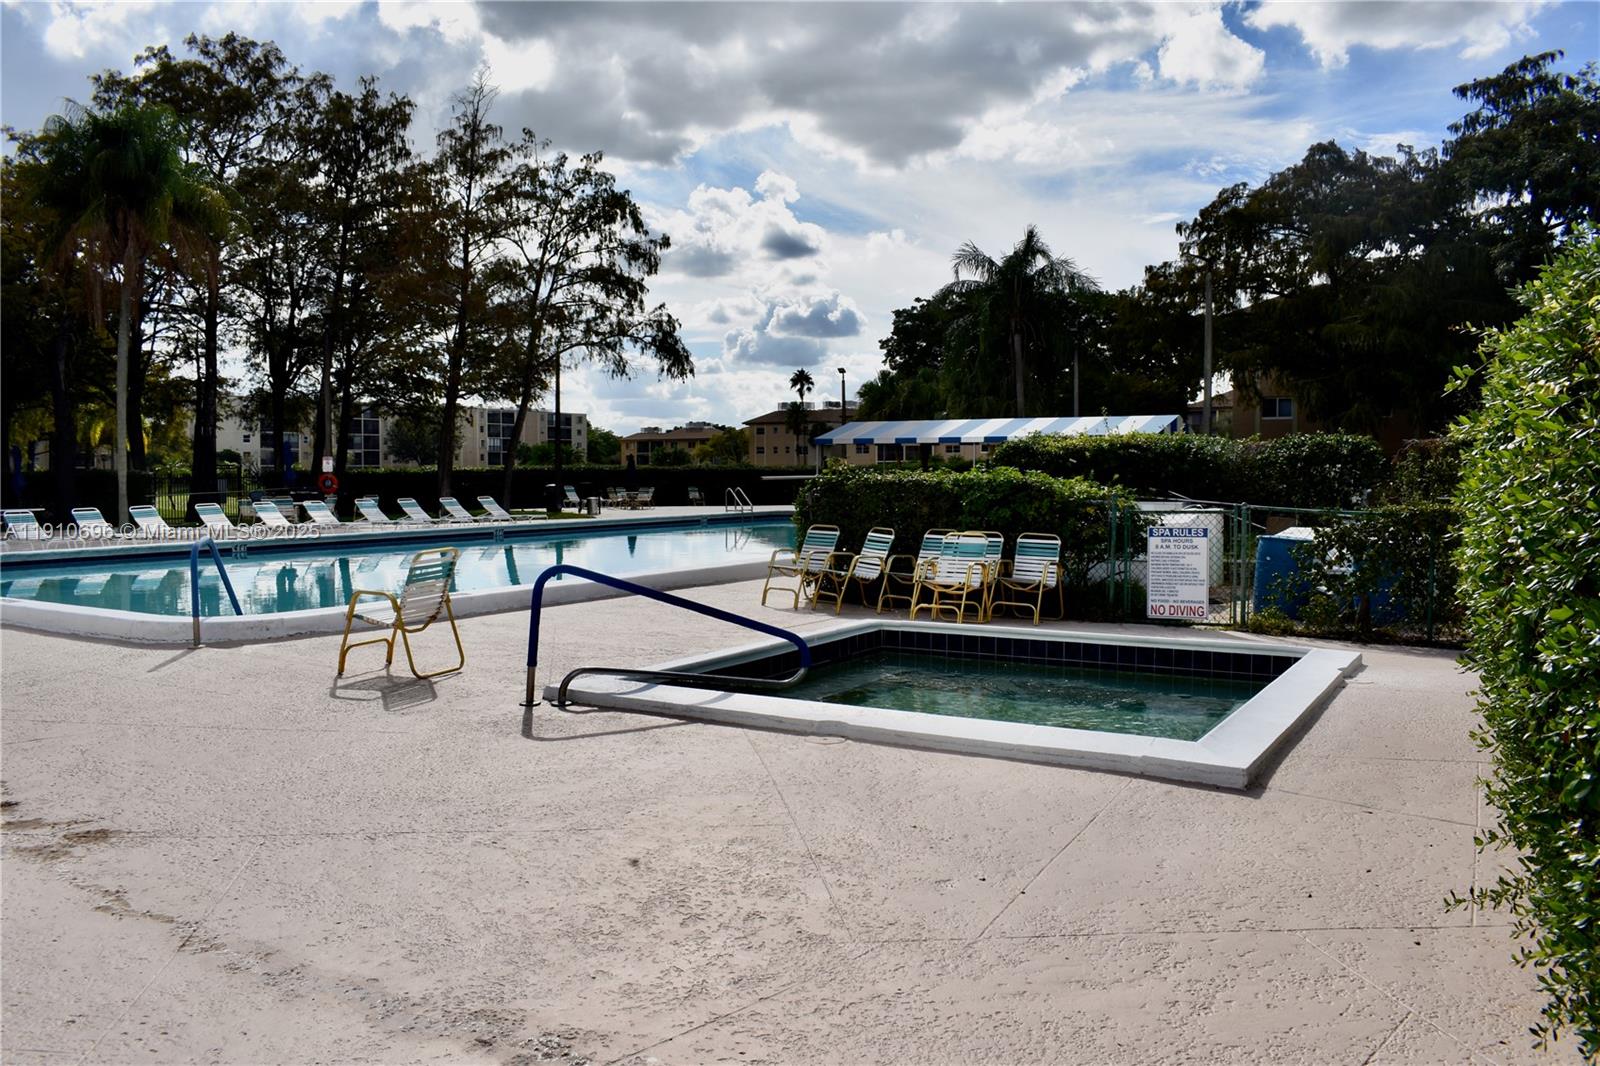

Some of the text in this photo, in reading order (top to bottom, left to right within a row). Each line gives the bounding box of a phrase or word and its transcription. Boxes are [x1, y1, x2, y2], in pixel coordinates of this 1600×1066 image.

[1152, 528, 1204, 537] SPA RULES
[1151, 604, 1205, 616] NO DIVING
